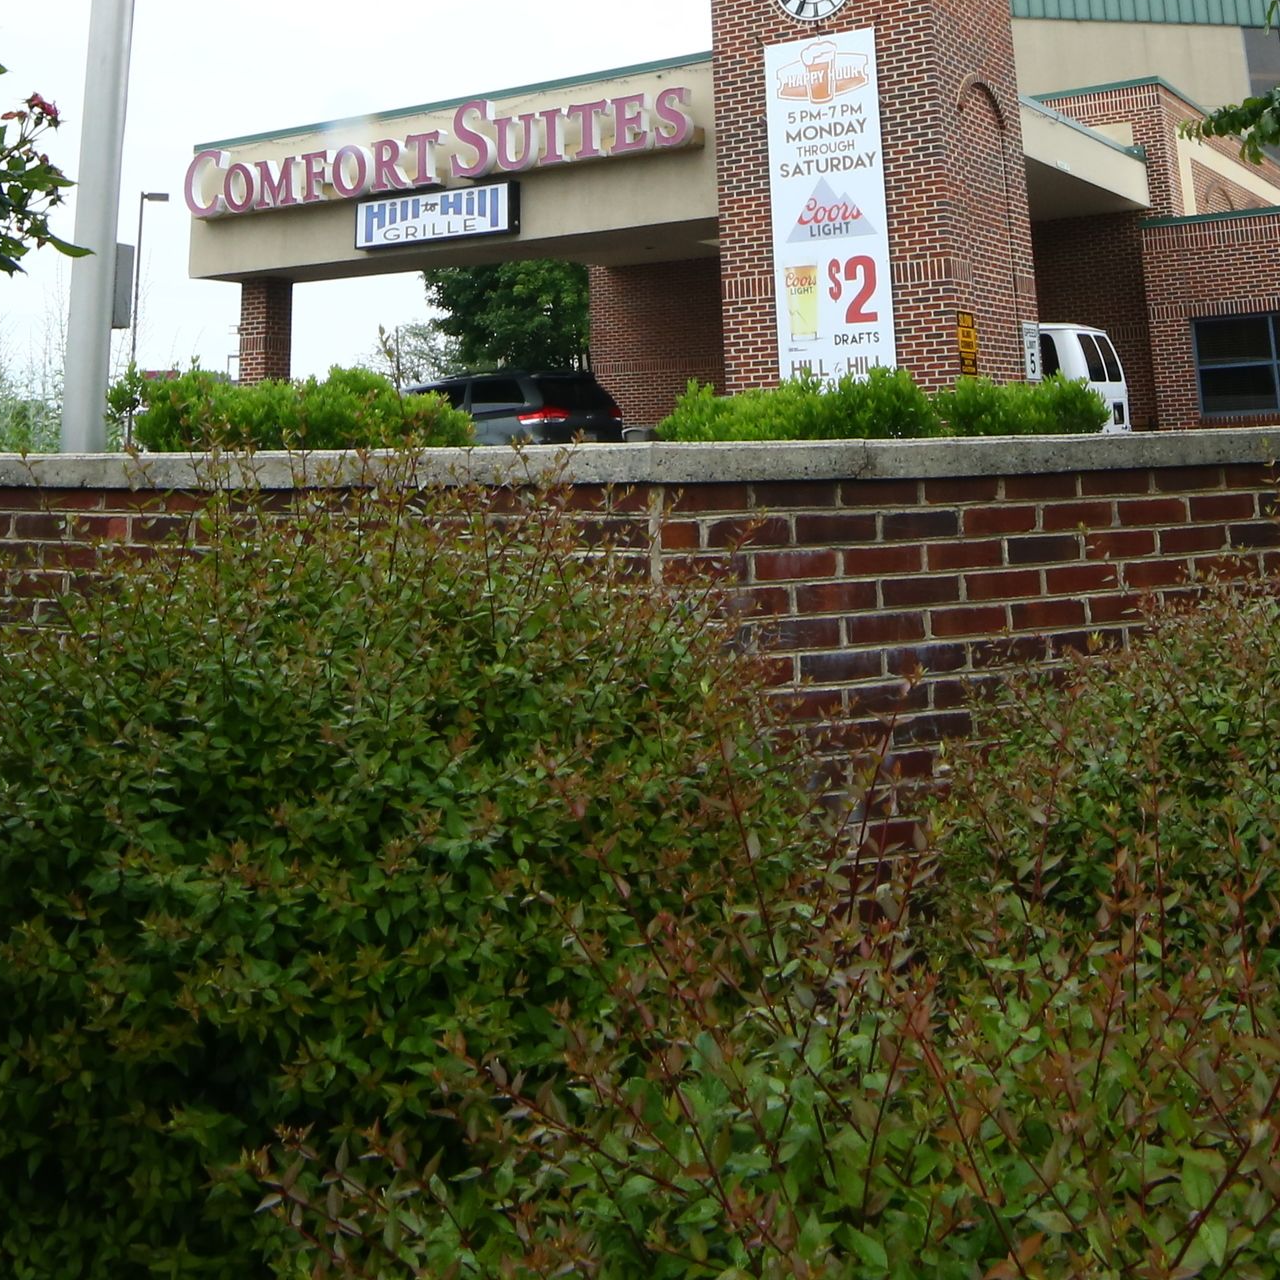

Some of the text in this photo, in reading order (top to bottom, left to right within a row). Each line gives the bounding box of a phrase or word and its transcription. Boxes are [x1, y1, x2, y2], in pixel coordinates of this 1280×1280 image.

[787, 70, 825, 88] HAPPY
[787, 111, 796, 124] 5
[841, 102, 863, 117] PM
[785, 117, 867, 144] MONDAY
[184, 87, 692, 218] COMFORT SUITES
[796, 139, 855, 158] THROUGH
[780, 151, 876, 178] SATURDAY
[365, 187, 499, 243] Hill to Hill
[797, 197, 863, 226] Coors
[383, 217, 478, 241] GRILLE
[809, 221, 851, 238] LIGHT
[785, 271, 817, 288] Coors
[828, 255, 879, 324] $2
[790, 286, 814, 296] LIGHT
[834, 331, 880, 346] DRAFTS
[1030, 353, 1036, 374] 5
